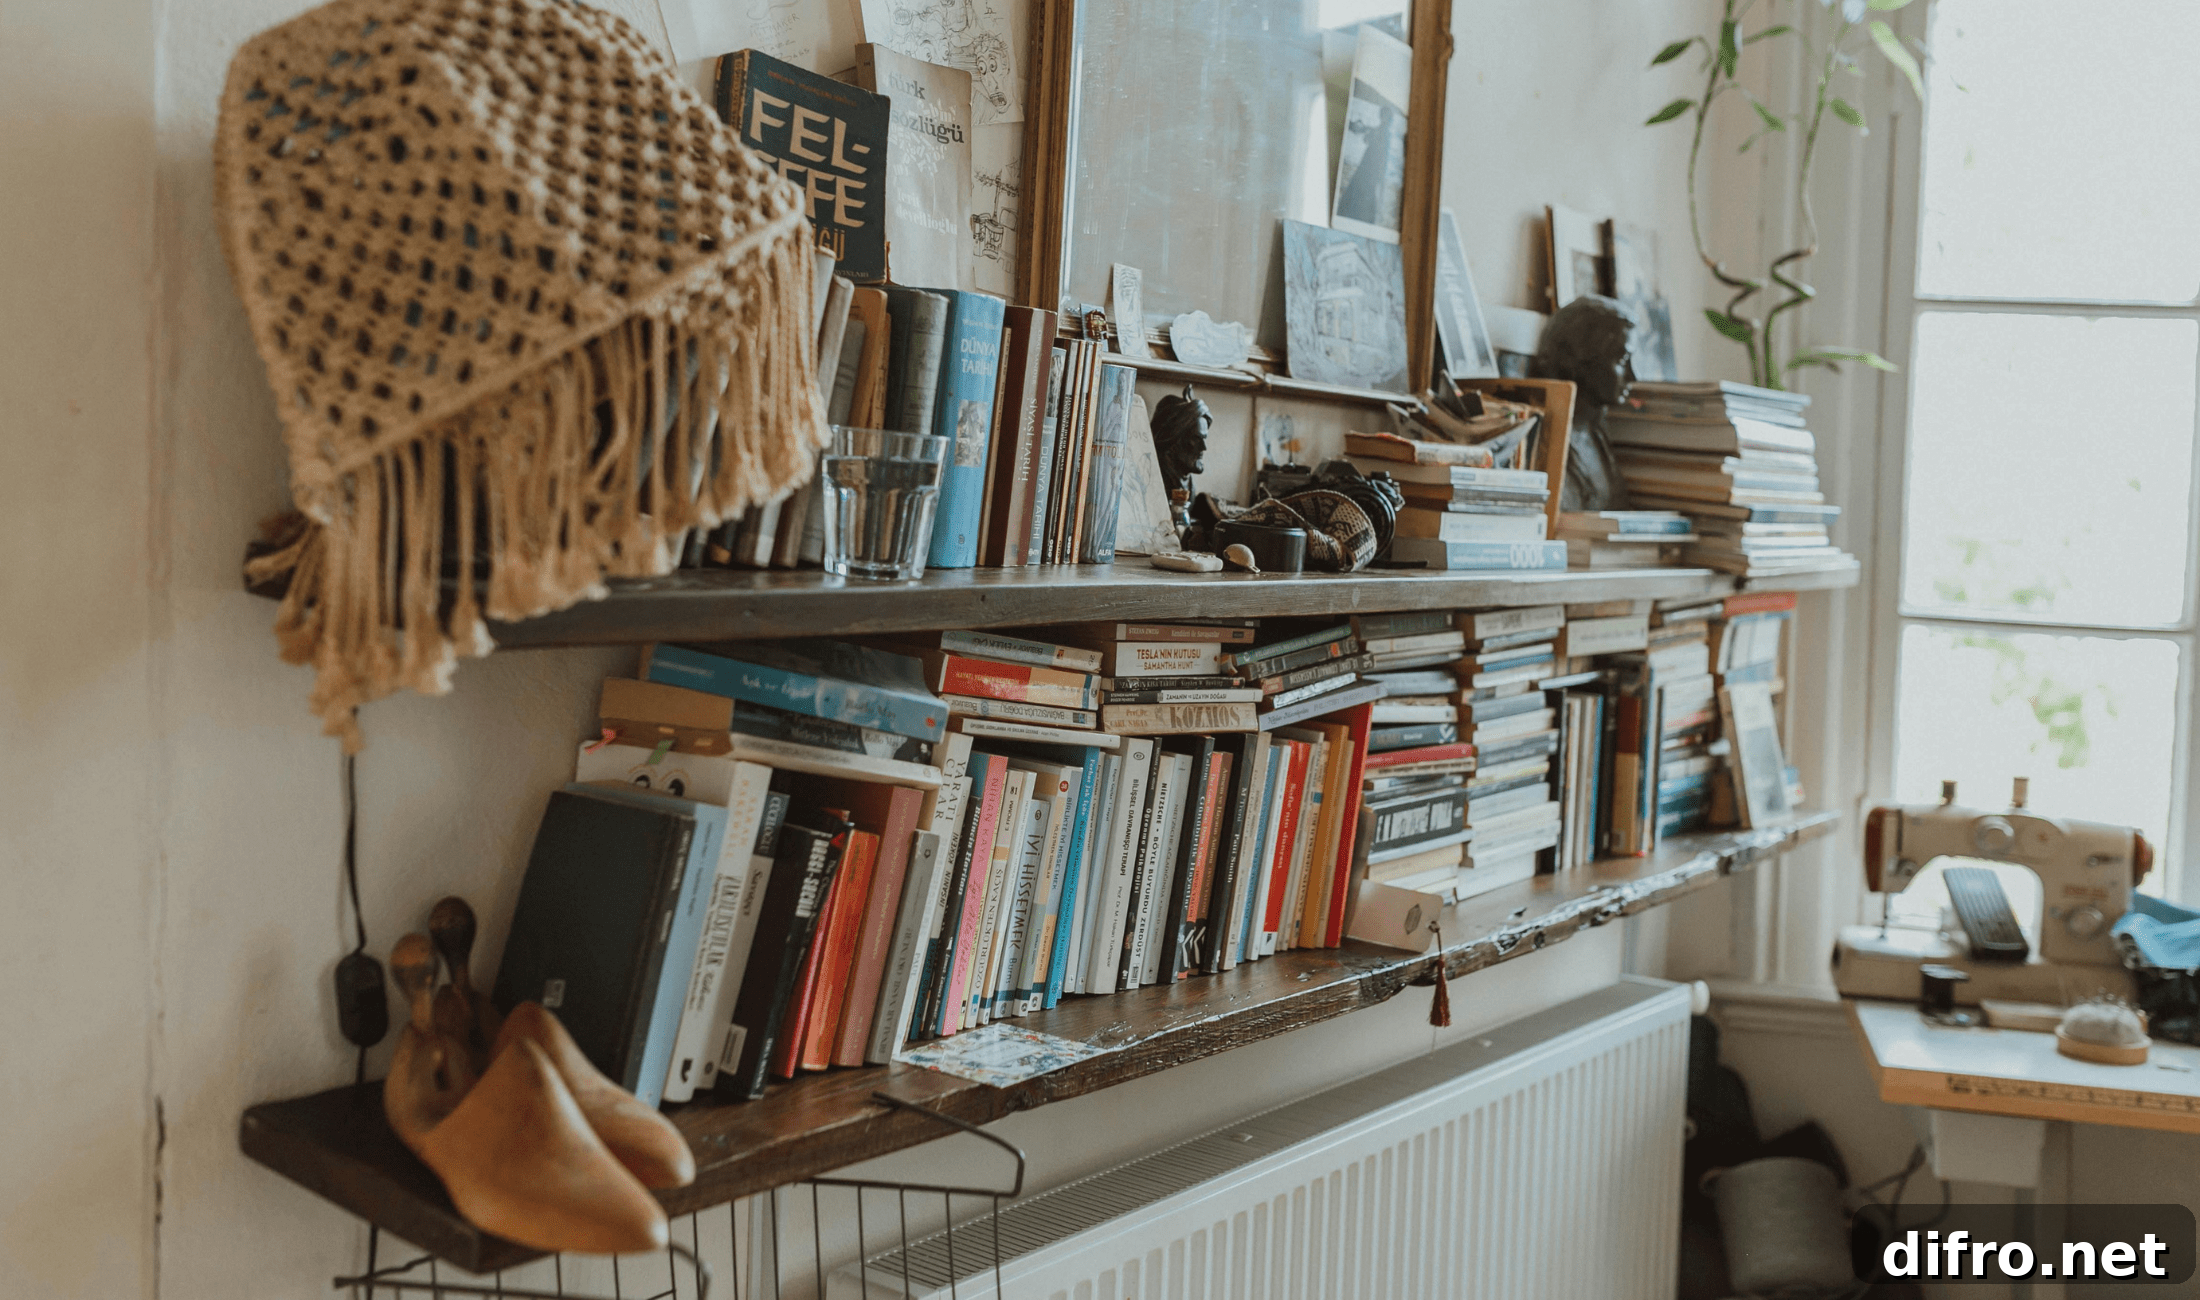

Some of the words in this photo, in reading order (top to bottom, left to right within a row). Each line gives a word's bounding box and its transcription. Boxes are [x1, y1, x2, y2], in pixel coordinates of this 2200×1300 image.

[889, 71, 926, 100] türk
[749, 88, 871, 175] FEL-
[892, 110, 965, 145] sözlüğü
[961, 336, 995, 356] DÜNYA
[1025, 397, 1038, 436] SİYASİ
[1098, 548, 1112, 556] ALFA
[1144, 662, 1176, 670] SAMANTHA
[1178, 661, 1194, 670] HUNT
[1174, 649, 1201, 659] KUTUSU
[1169, 705, 1240, 727] KOZMOS
[1202, 751, 1211, 781] Yalom
[932, 757, 956, 821] CILAR
[943, 759, 967, 822] YARATI
[1128, 778, 1140, 809] BİLİŞSEL
[1240, 787, 1246, 796] M
[966, 805, 981, 848] Bilincin
[1121, 808, 1136, 851] DAVRANIŞÇI
[1024, 833, 1043, 857] İYİ
[1148, 835, 1160, 866] BÖYLE
[1231, 833, 1240, 854] Patti
[1118, 851, 1129, 876] TERAPİ
[1132, 847, 1146, 894] Psikolojisi
[1226, 855, 1236, 883] Smith
[1141, 868, 1154, 914] BUYURDU
[1182, 861, 1195, 910] Hayatlar
[1008, 862, 1037, 950] HİSSETMEK
[972, 904, 997, 989] ÖZGÜRLÜKTEN
[989, 867, 1003, 902] KAÇIŞ
[1133, 917, 1147, 958] ZERDÜŞT
[1004, 956, 1017, 985] Burns
